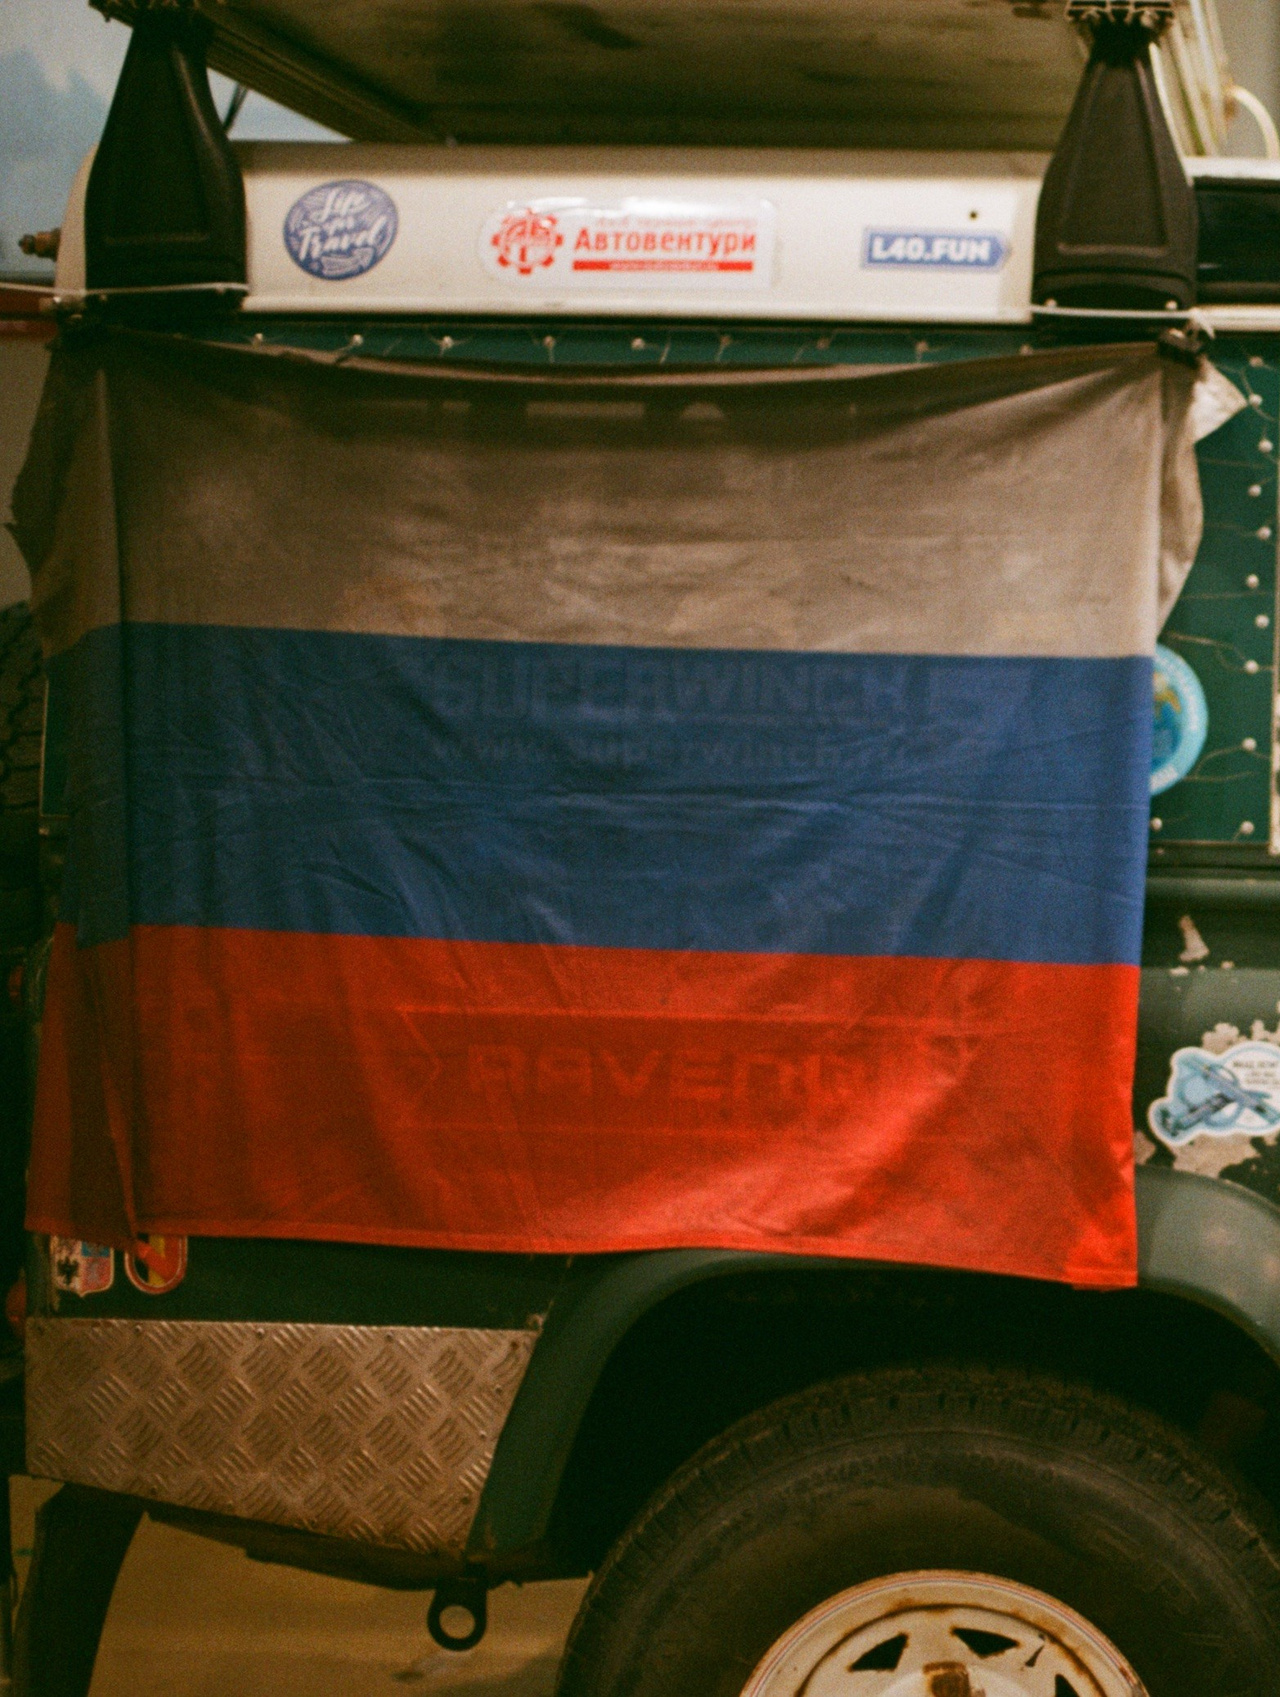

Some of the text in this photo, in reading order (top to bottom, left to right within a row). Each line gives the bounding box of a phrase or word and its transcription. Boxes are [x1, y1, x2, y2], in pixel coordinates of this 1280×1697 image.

[298, 215, 387, 262] Travel
[573, 227, 757, 258] Автовентури
[871, 233, 992, 263] L40.FUN
